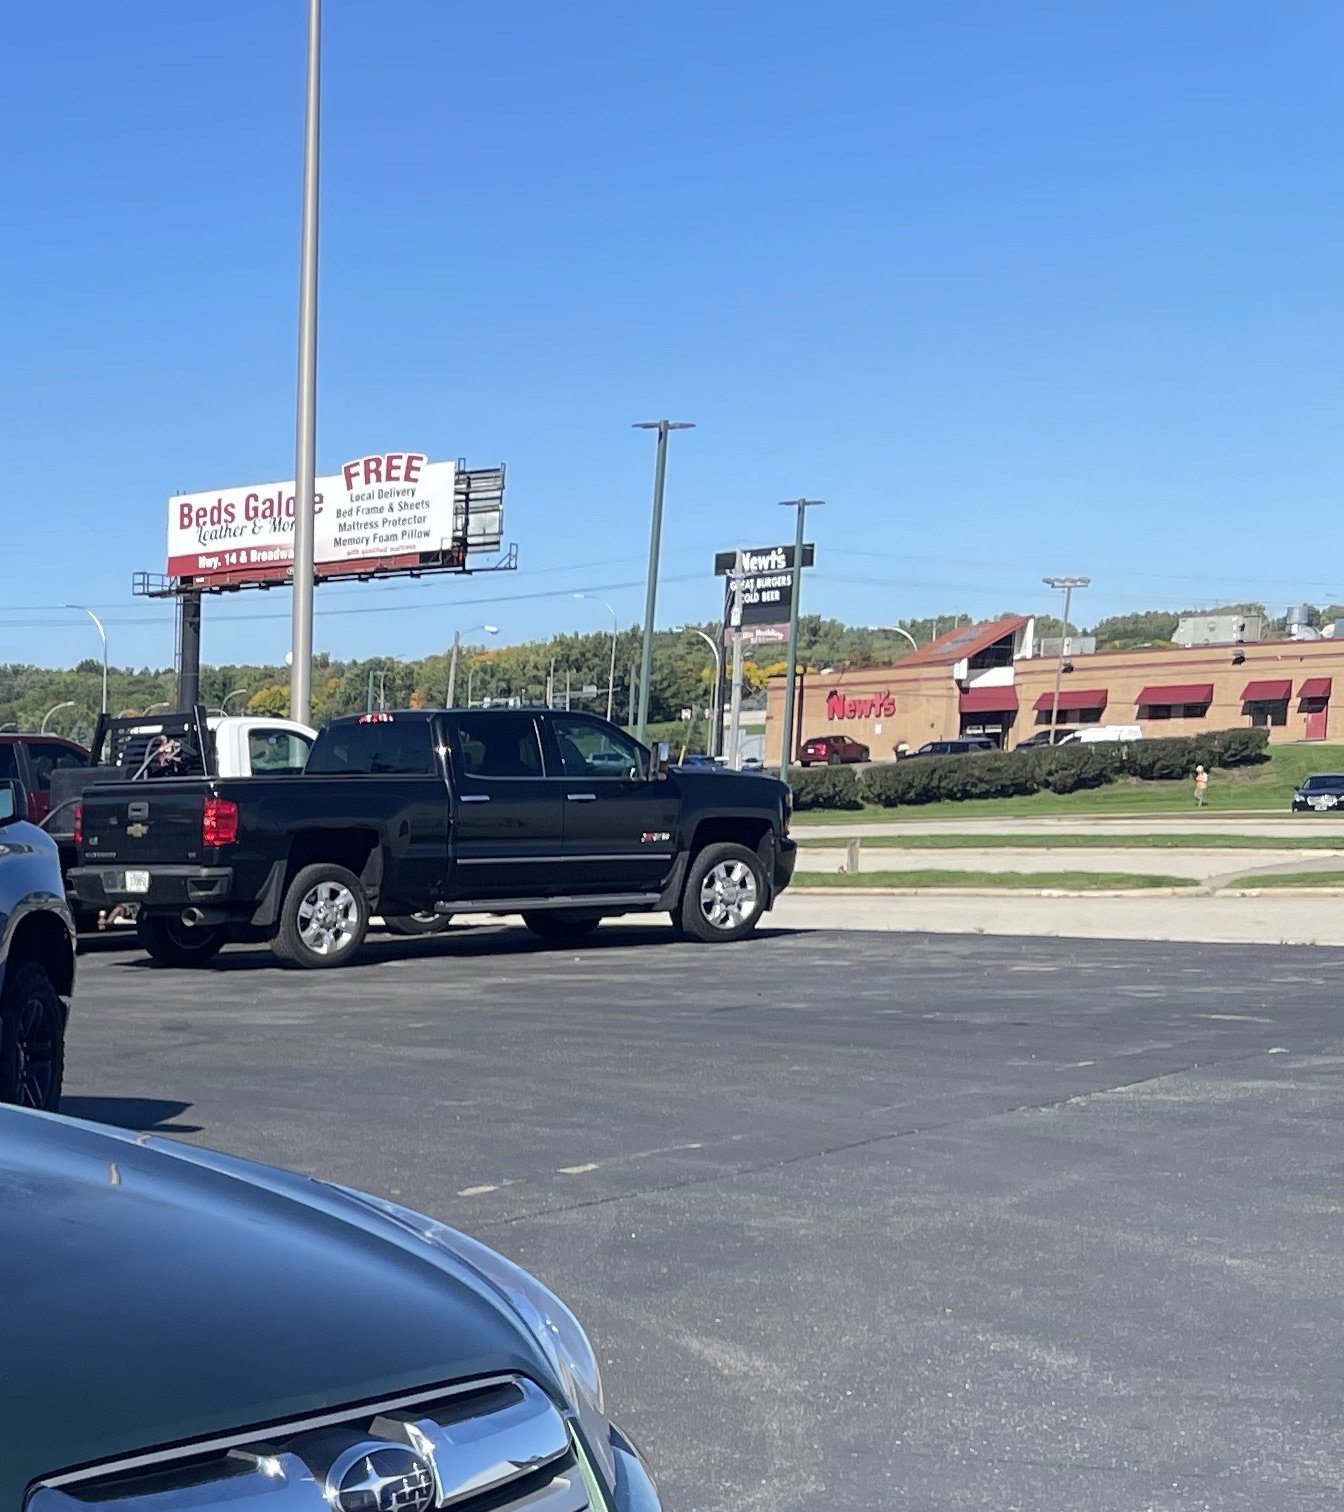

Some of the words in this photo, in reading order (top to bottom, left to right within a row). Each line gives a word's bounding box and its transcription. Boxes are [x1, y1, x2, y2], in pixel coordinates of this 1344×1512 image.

[343, 455, 424, 491] FREE
[349, 490, 375, 502] Local
[378, 487, 417, 500] Delivery
[179, 498, 236, 530] Beds
[245, 490, 324, 522] Galoe
[336, 507, 353, 519] Bed
[356, 504, 384, 516] Frame
[387, 502, 395, 513] &
[398, 499, 430, 512] Sheets
[197, 523, 247, 546] Leather
[251, 519, 263, 536] &
[338, 520, 379, 533] Mattress
[382, 514, 427, 528] Protector
[333, 535, 370, 548] Memory
[373, 532, 398, 543] Foam
[401, 529, 431, 540] Pillow
[224, 552, 237, 565] 14
[239, 550, 248, 564] &
[250, 547, 296, 562] Broadwa
[756, 575, 792, 589] BURGERS
[742, 592, 760, 604] OLD
[761, 590, 781, 603] BEER
[826, 689, 896, 721] Newt's
